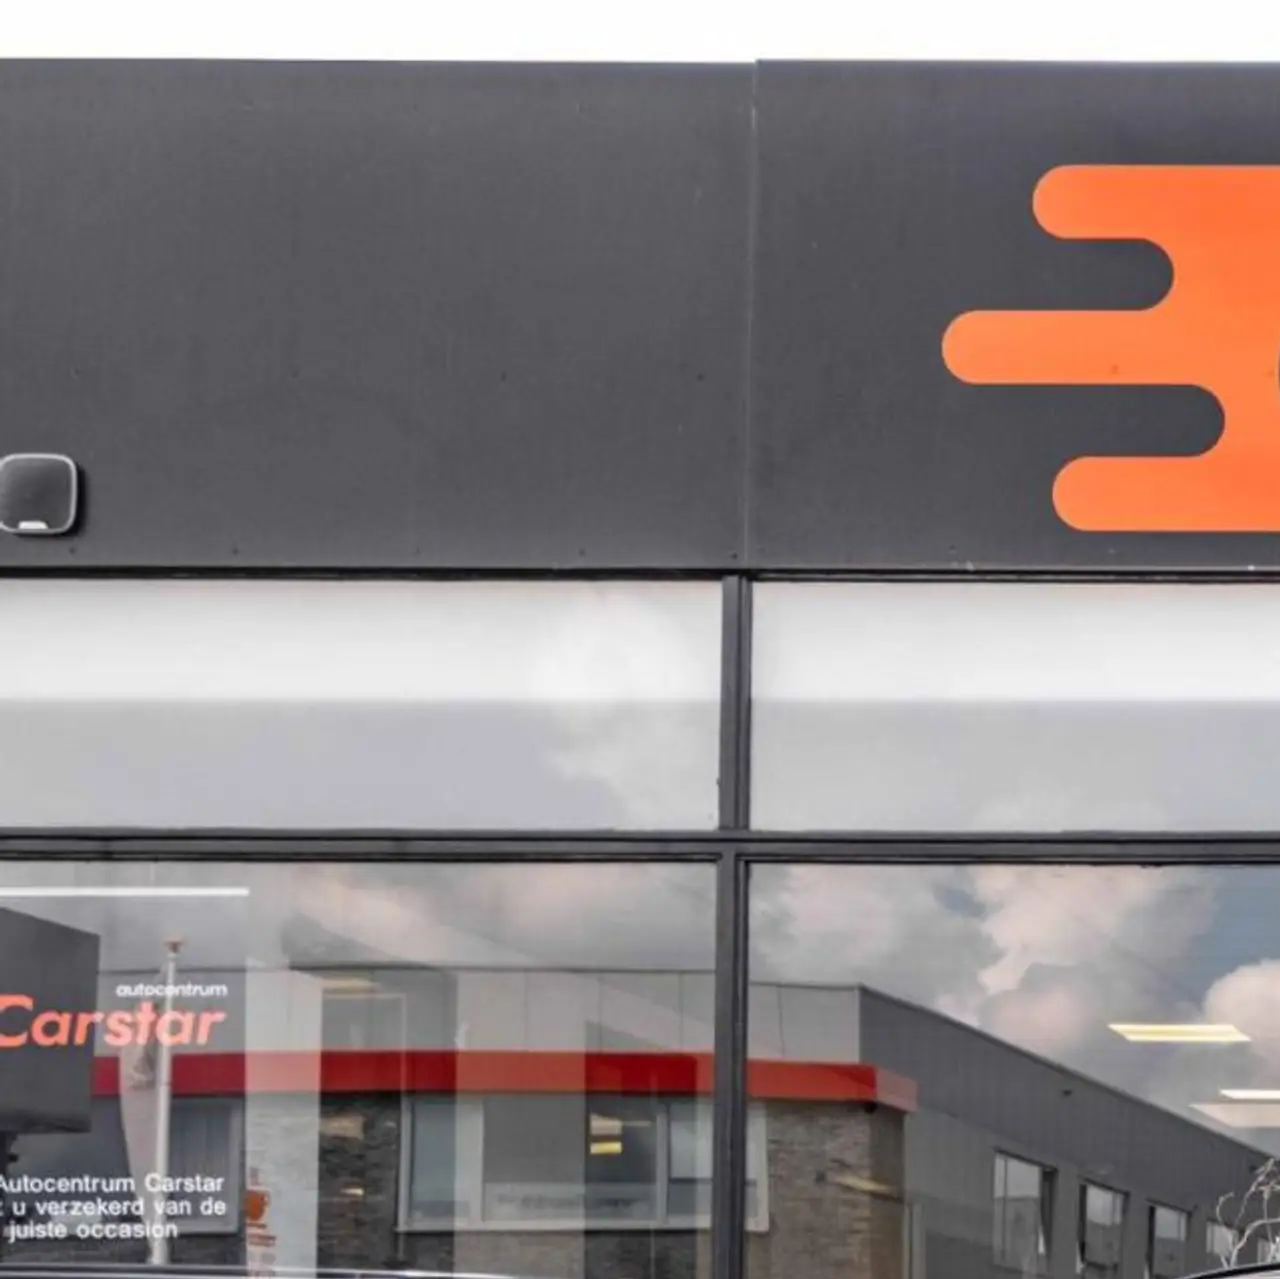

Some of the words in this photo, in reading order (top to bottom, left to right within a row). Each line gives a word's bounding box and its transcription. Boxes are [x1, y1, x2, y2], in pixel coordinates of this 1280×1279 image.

[116, 982, 228, 997] autocentrum
[0, 1174, 135, 1192] Autocentrum
[144, 1173, 225, 1192] Carstar
[12, 1203, 26, 1216] u
[35, 1198, 145, 1215] verzekerd
[153, 1202, 192, 1216] van
[200, 1197, 227, 1215] de
[8, 1219, 68, 1243] juiste
[76, 1219, 178, 1239] occasion
